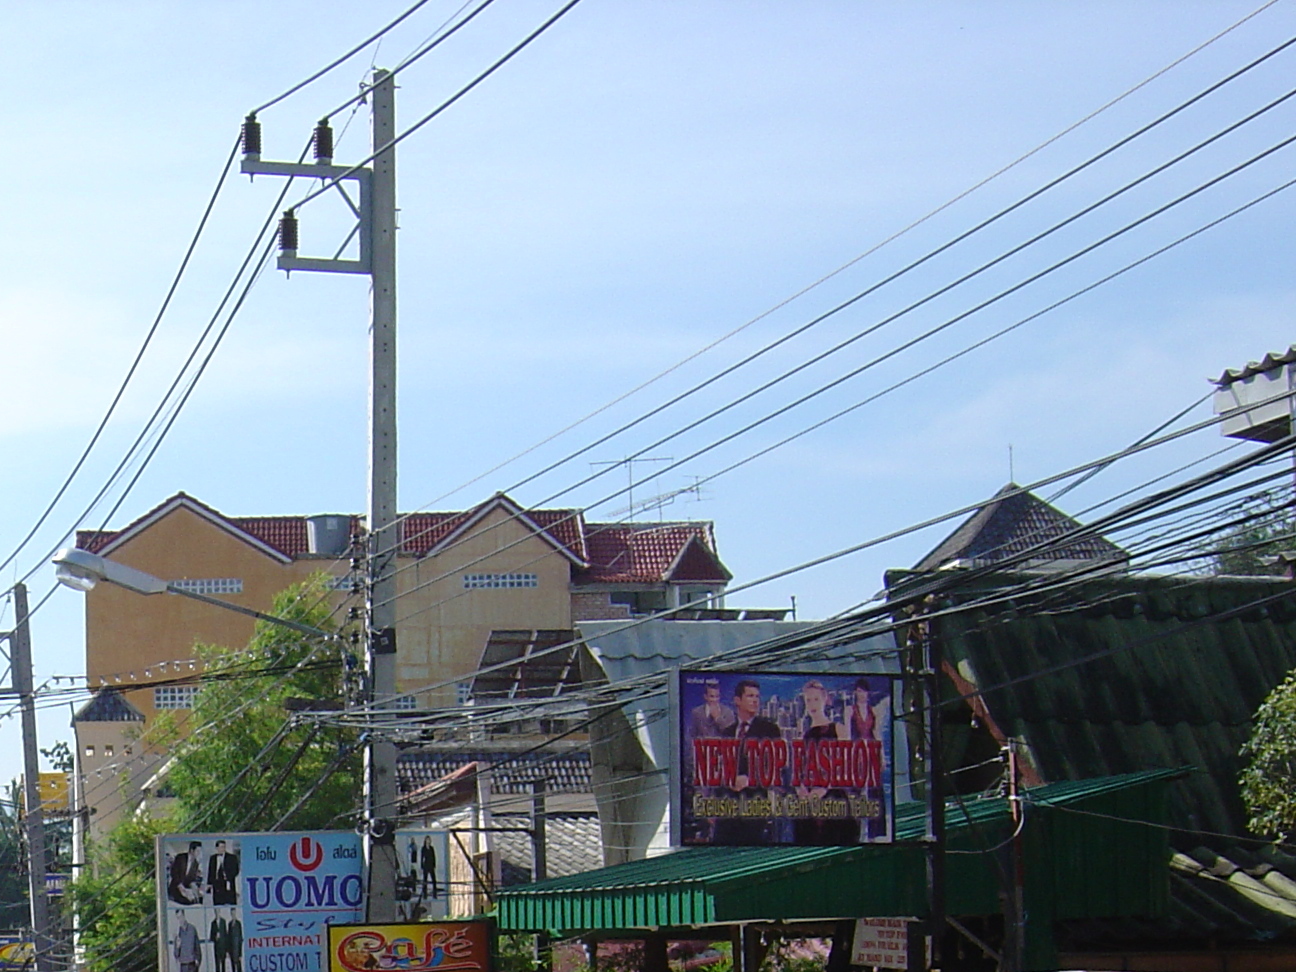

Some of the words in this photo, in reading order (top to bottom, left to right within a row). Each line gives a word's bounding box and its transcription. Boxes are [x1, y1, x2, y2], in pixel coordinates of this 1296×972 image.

[693, 738, 740, 787] NEW
[745, 739, 788, 788] TOP
[792, 739, 884, 788] FASHION
[694, 795, 739, 818] Exclusive
[741, 795, 773, 817] Ladies
[775, 796, 783, 816] &
[786, 796, 810, 817] Gent
[812, 796, 847, 817] Custom
[850, 795, 880, 818] Tailors
[246, 874, 363, 909] UOMO
[249, 952, 308, 972] CUSTOM
